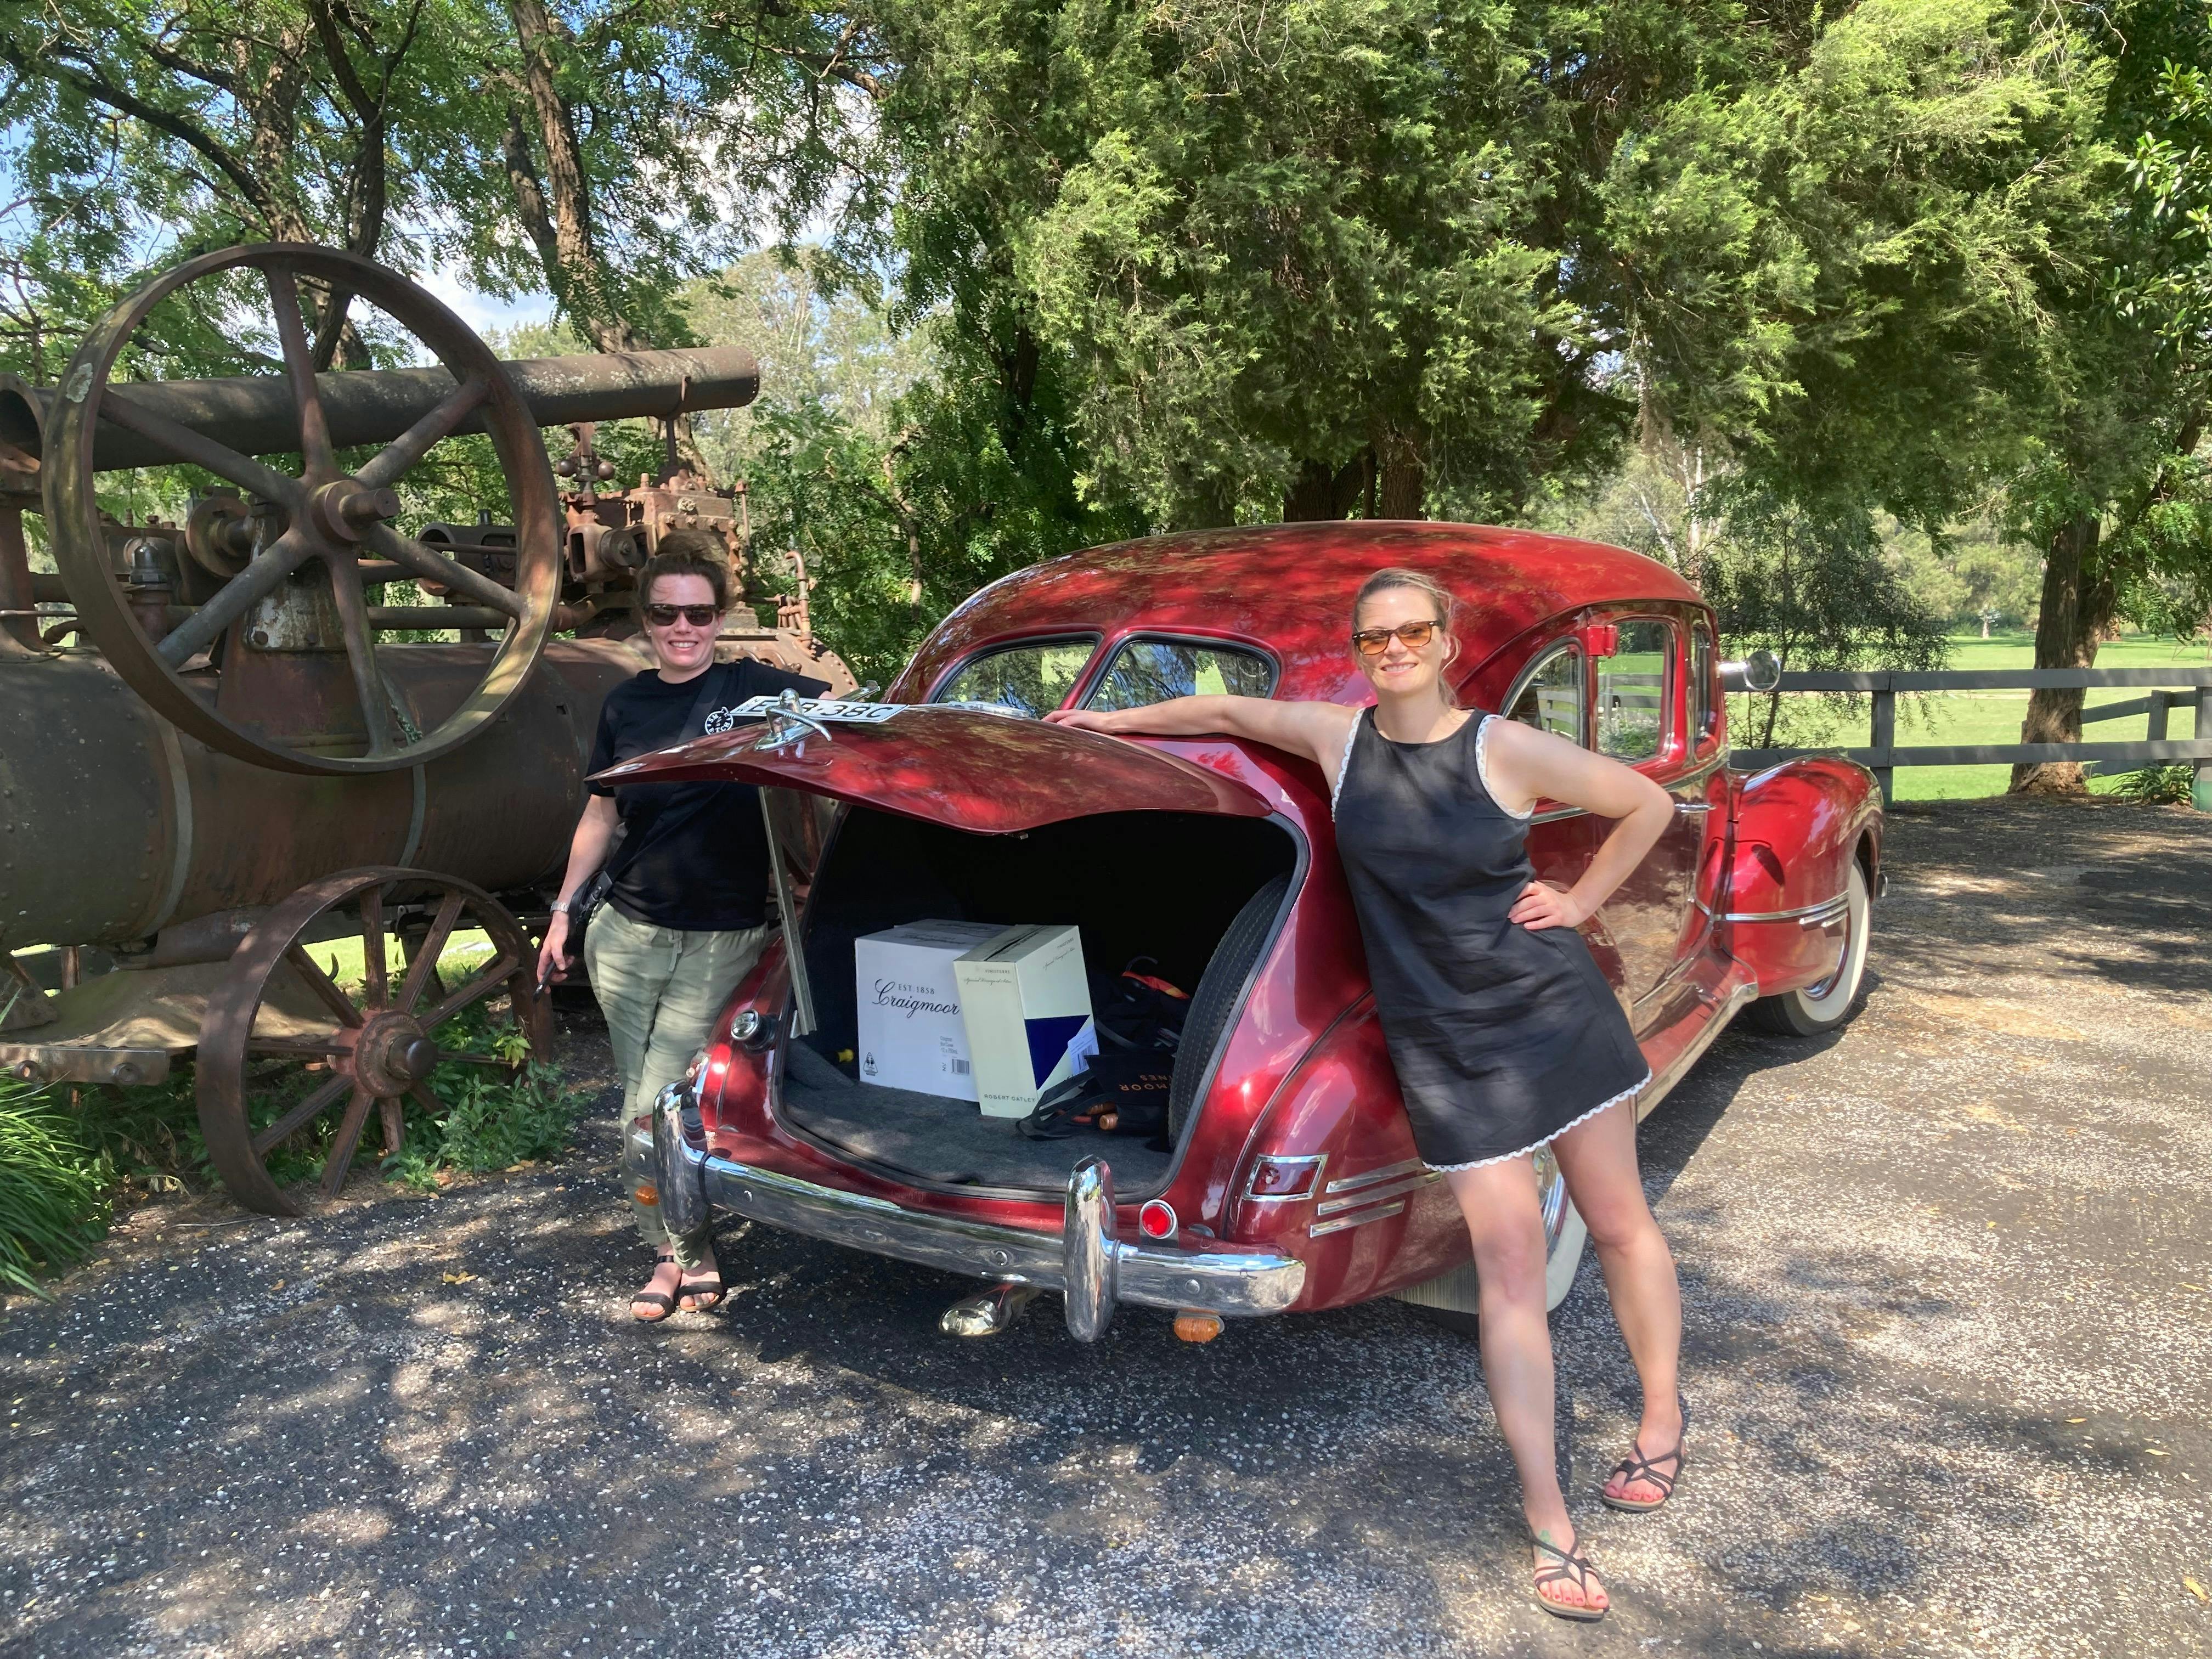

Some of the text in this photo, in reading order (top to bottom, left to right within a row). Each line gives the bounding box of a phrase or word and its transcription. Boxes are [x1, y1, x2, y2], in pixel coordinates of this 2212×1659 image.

[872, 978, 961, 1019] Craigmoor
[898, 984, 935, 995] EST 1858
